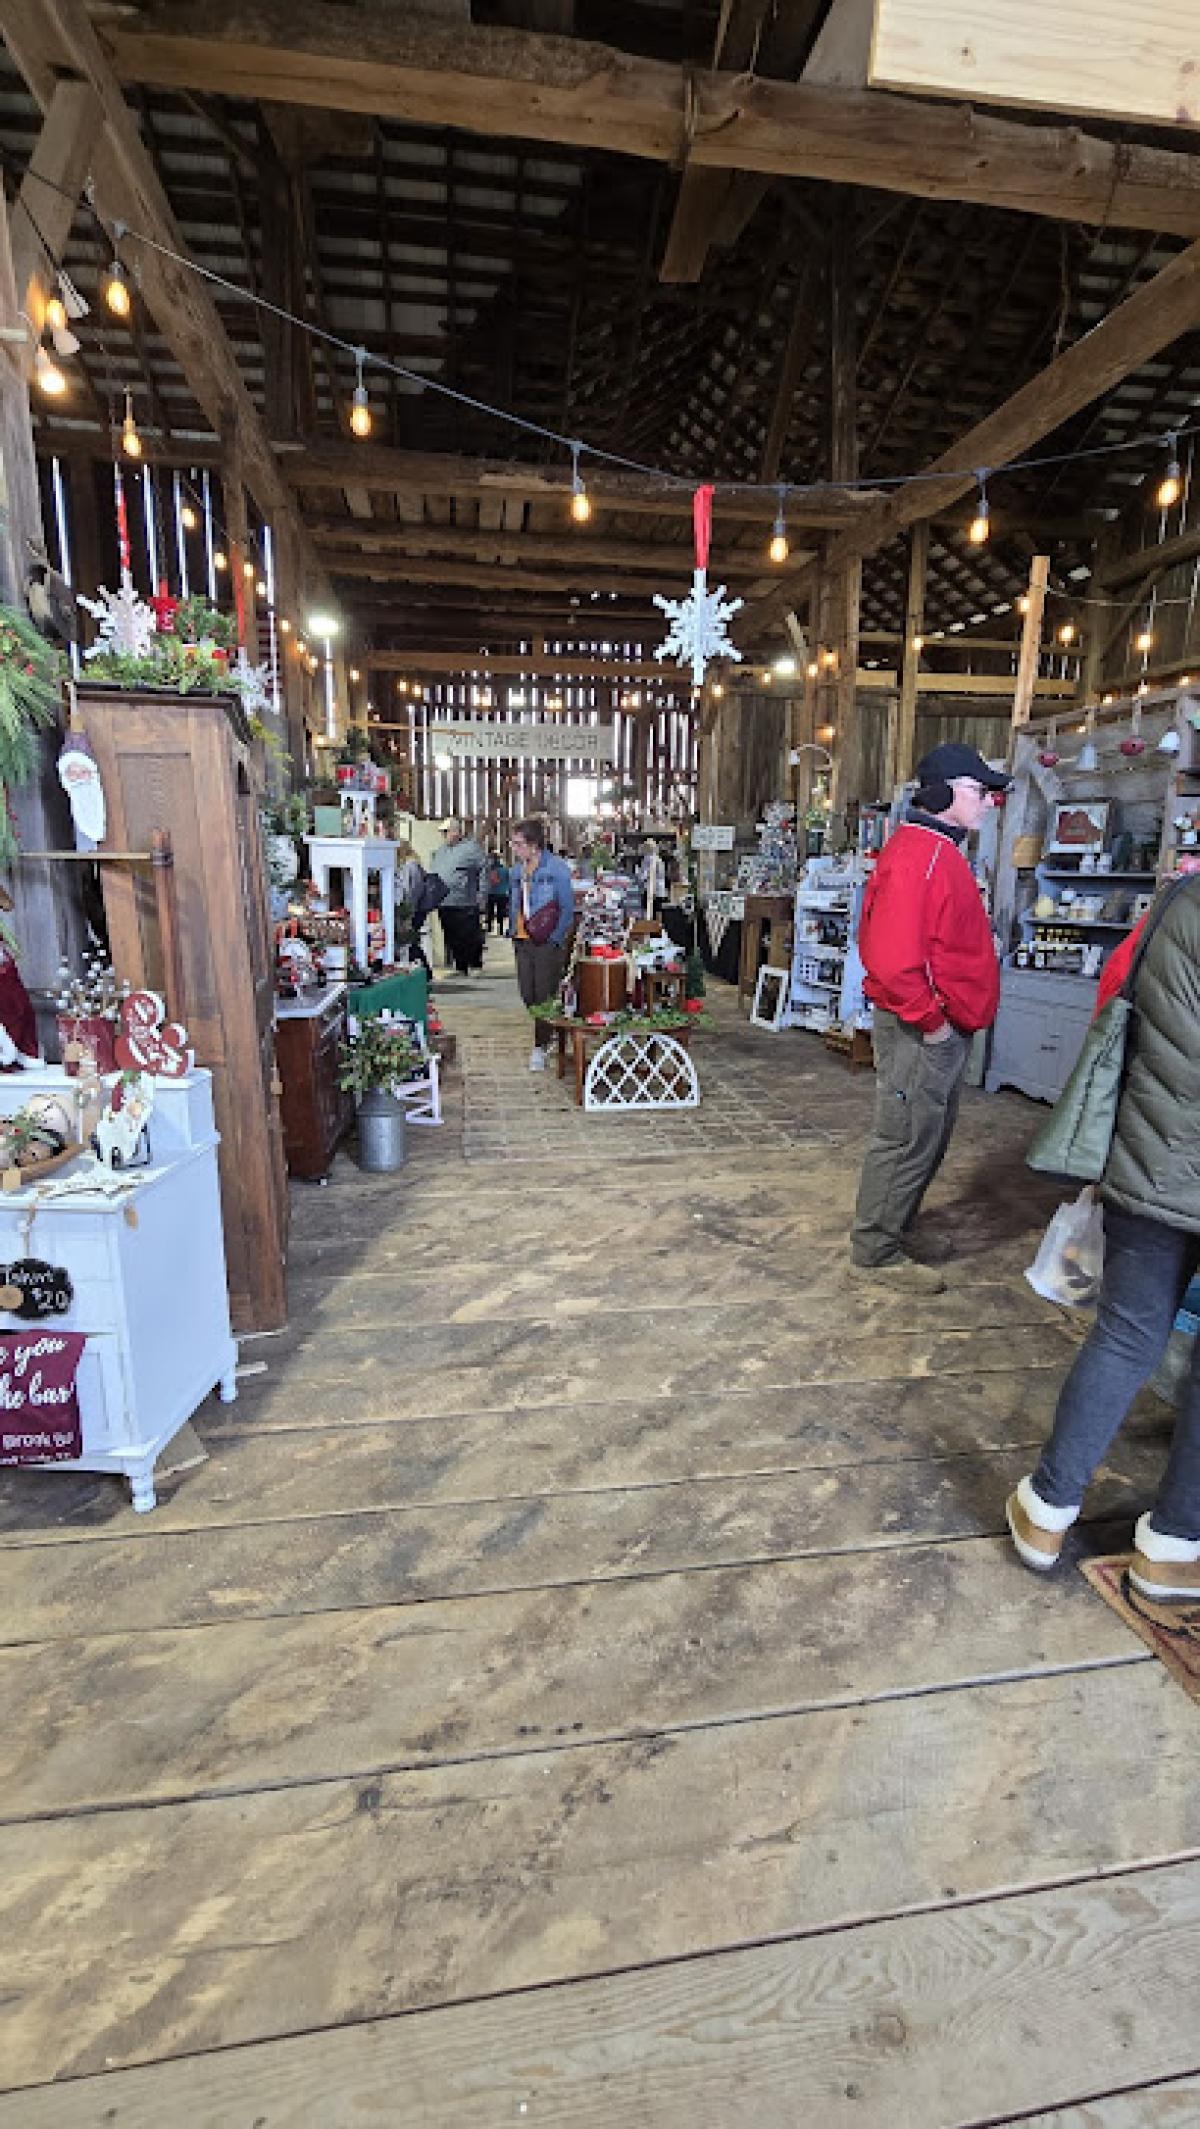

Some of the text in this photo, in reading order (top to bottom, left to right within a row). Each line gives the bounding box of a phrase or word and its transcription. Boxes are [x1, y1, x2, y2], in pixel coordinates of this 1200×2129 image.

[451, 730, 530, 748] VINTAGE
[15, 1337, 67, 1377] you
[29, 1370, 74, 1406] bar
